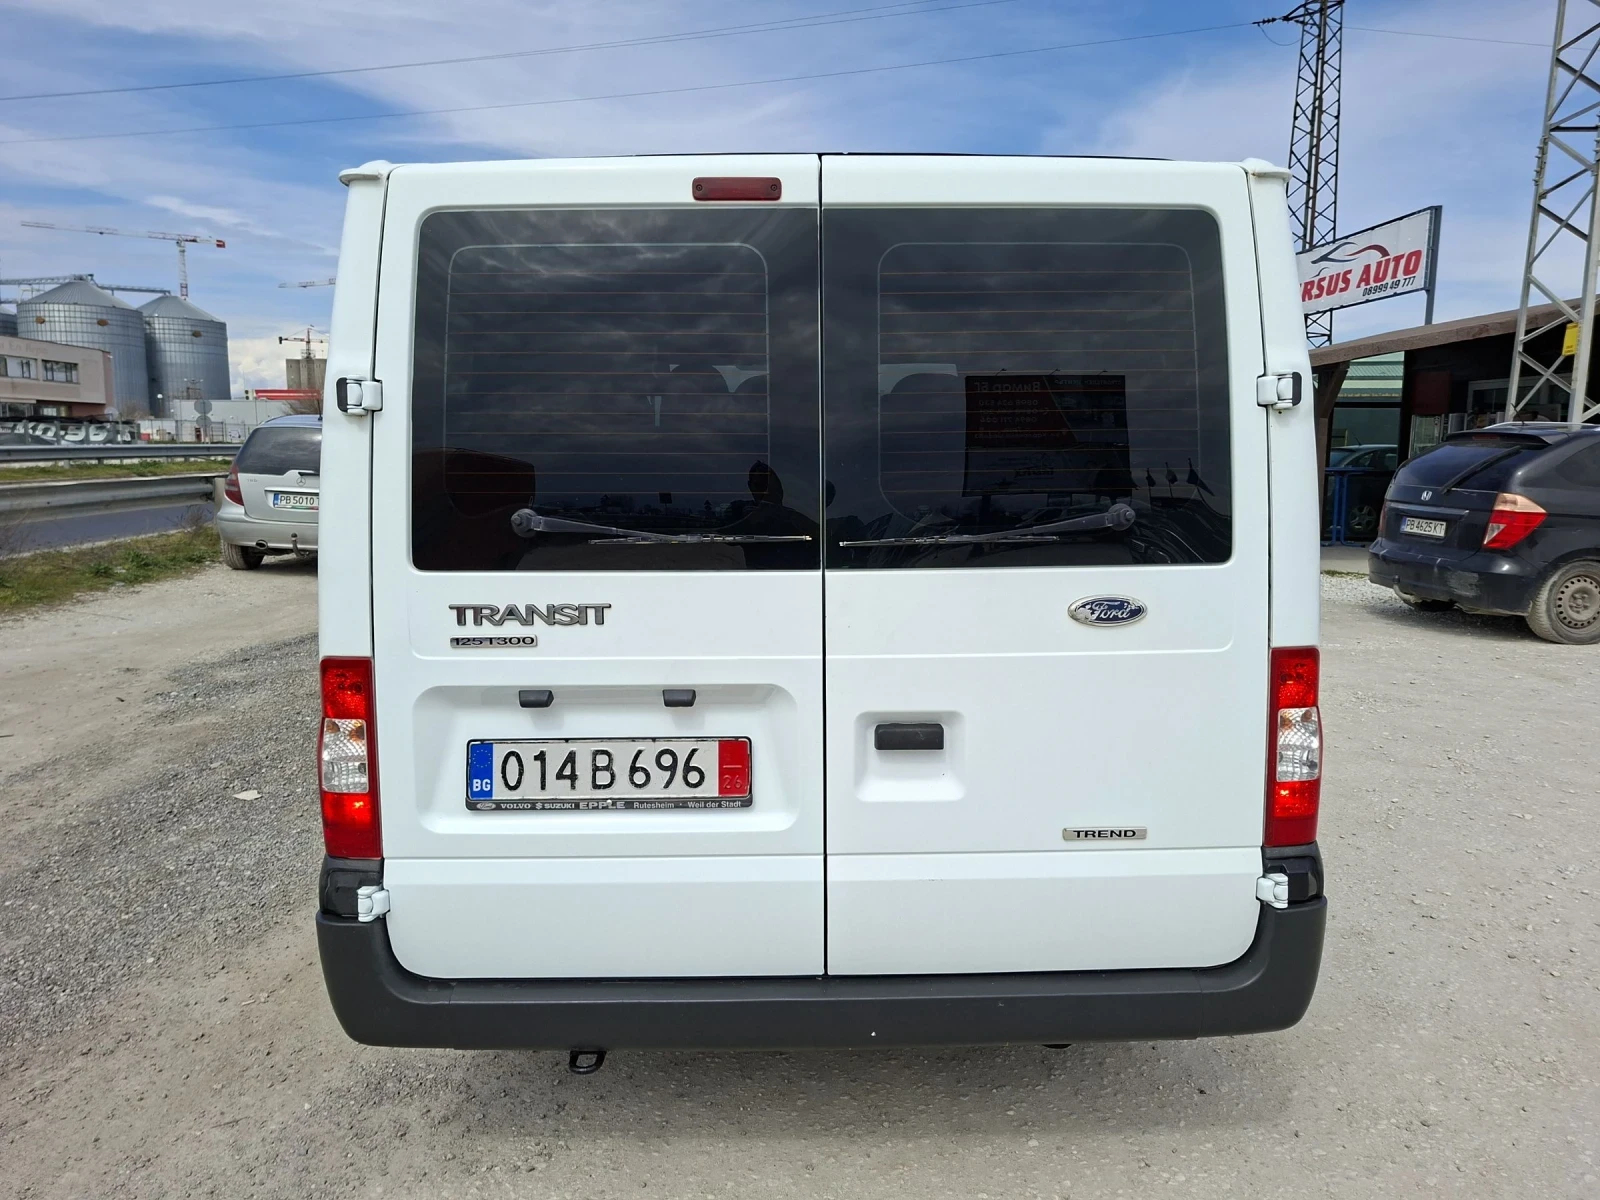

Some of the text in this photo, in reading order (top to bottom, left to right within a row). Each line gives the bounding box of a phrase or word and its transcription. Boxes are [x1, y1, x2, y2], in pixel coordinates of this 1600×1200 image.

[1300, 249, 1423, 303] RSUS AUTO
[1362, 275, 1417, 297] 08999 49 777
[1415, 520, 1433, 533] 4625
[449, 603, 612, 626] TRANSIT
[1091, 600, 1132, 621] Ford
[472, 779, 491, 791] BG
[723, 774, 743, 789] 26
[579, 801, 626, 810] EPPLE
[633, 801, 675, 810] Rutesheim
[688, 800, 705, 809] Weil
[706, 800, 719, 809] der
[721, 800, 741, 809] Stadt
[1072, 829, 1137, 838] TREND
